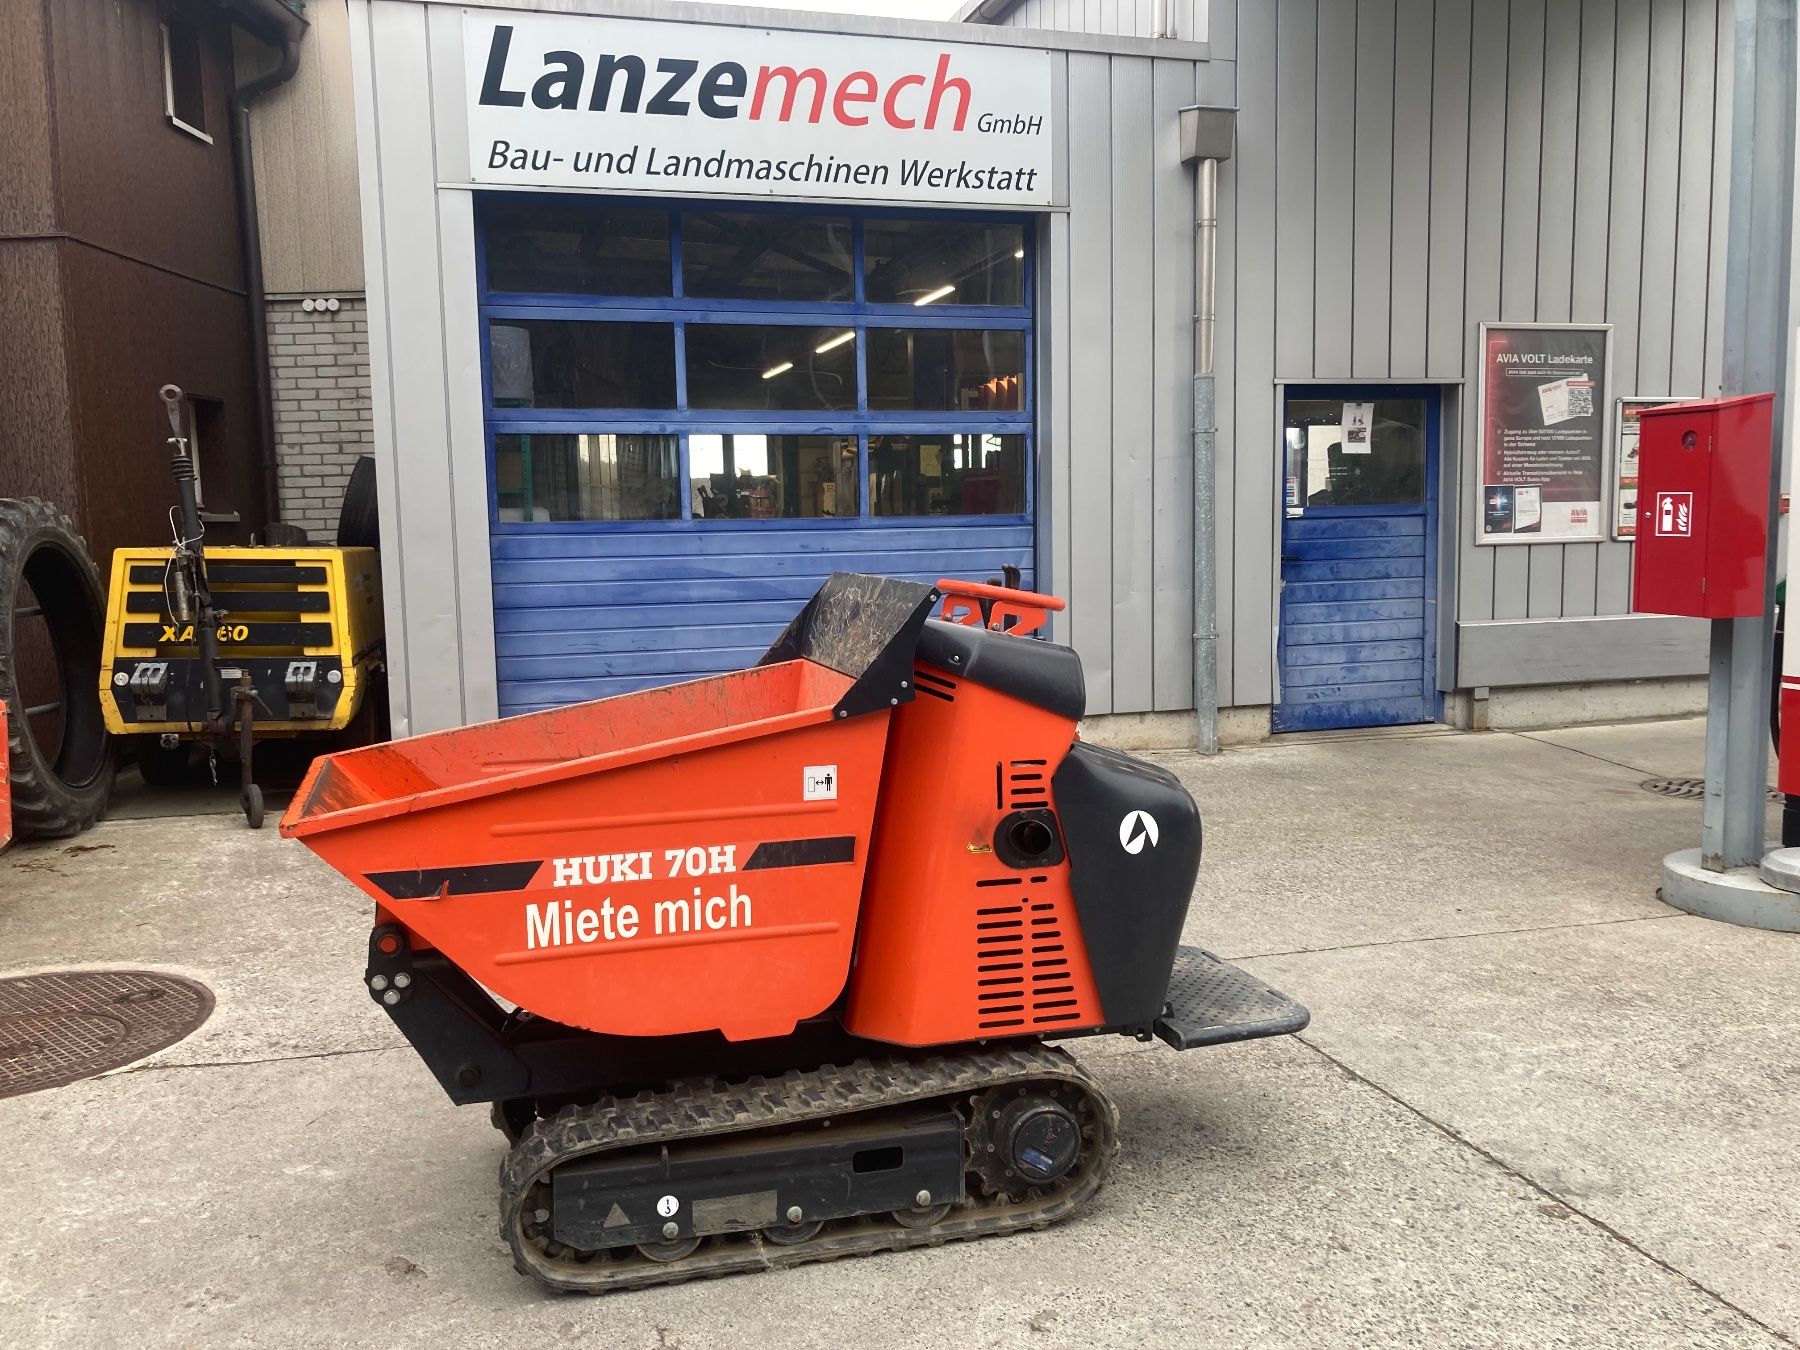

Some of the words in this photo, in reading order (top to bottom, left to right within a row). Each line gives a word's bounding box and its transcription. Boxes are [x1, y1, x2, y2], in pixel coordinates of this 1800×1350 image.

[479, 25, 972, 132] Lanzemech
[977, 112, 1043, 136] GmbH
[488, 140, 564, 171] Bau-
[573, 145, 638, 175] und
[646, 147, 889, 186] Landmaschinen
[900, 159, 1038, 191] Werkstatt
[1496, 353, 1519, 363] AVIA
[1521, 354, 1546, 364] VOLT
[1547, 354, 1593, 364] Ladekarte
[159, 625, 248, 642] XA60
[552, 851, 653, 888] HUKI
[665, 844, 738, 879] 70H
[526, 897, 640, 949] Miete
[654, 884, 753, 934] mich
